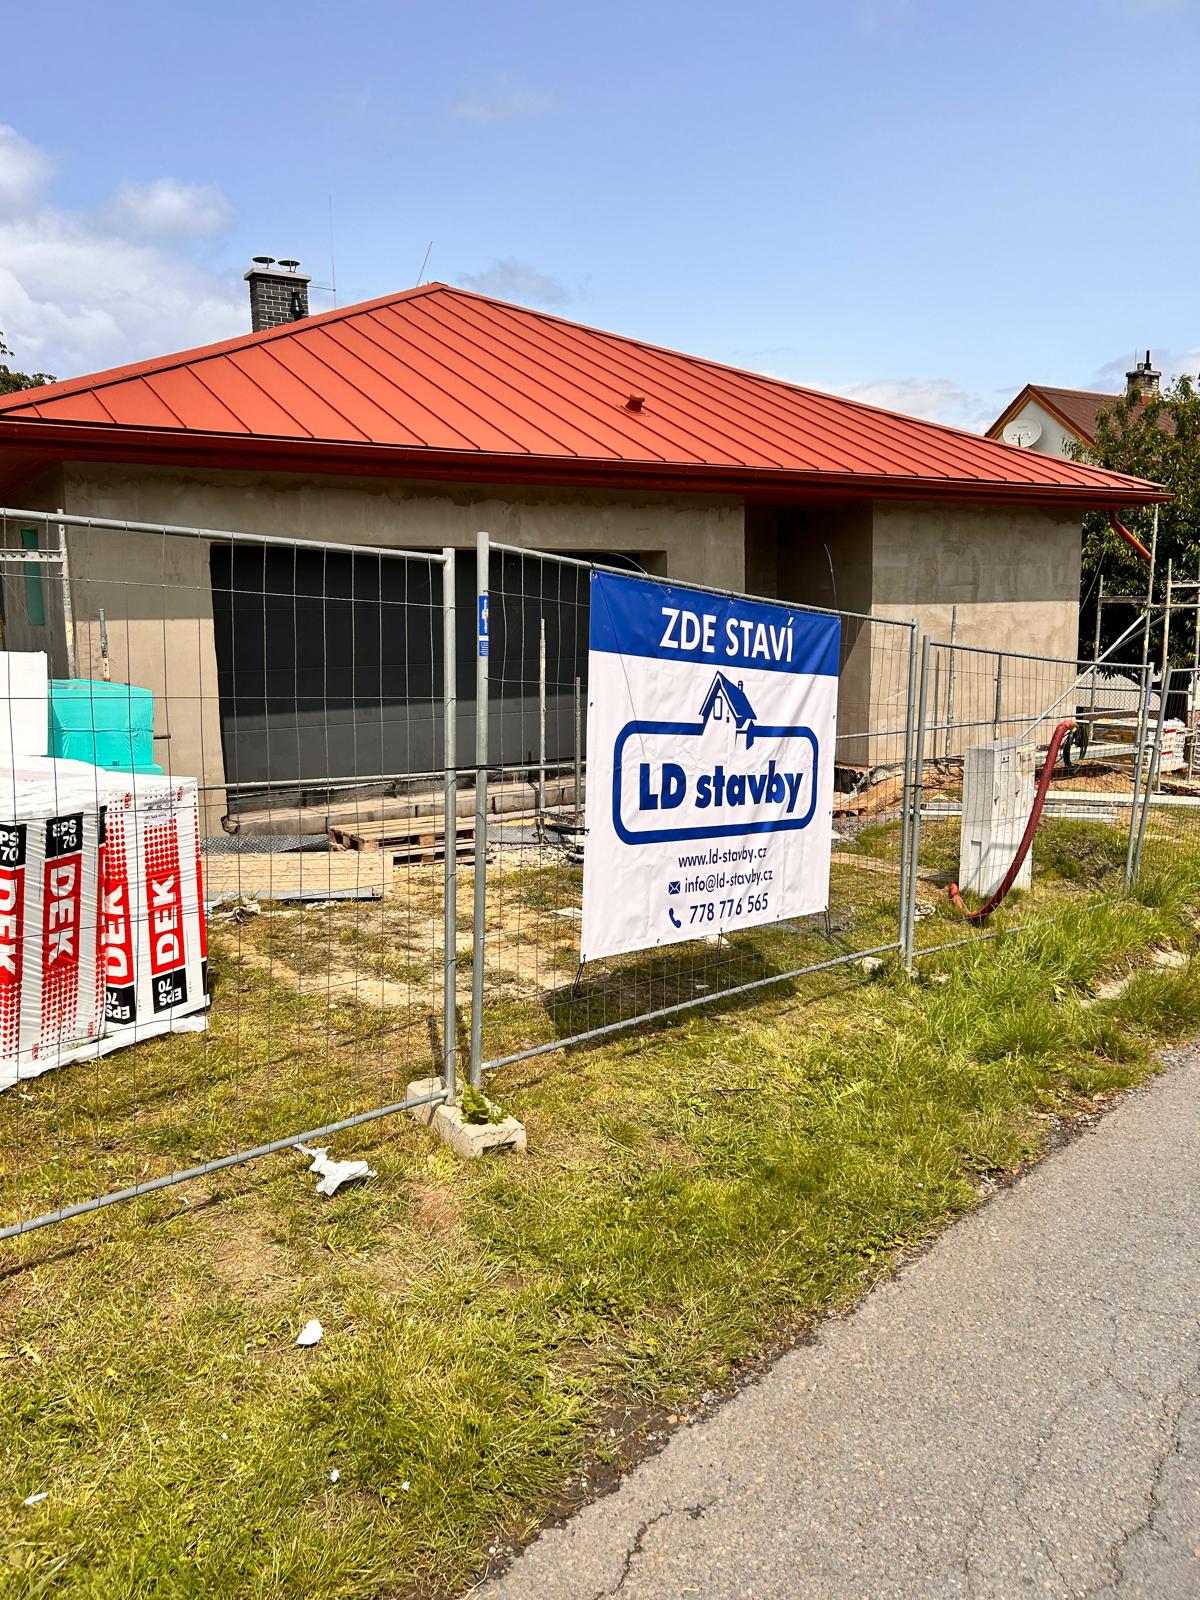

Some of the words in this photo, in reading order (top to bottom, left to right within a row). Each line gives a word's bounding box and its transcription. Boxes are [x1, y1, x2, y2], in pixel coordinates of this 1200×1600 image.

[660, 607, 717, 653] ZDE
[725, 616, 793, 662] STAVÍ
[638, 762, 687, 811] LD
[695, 760, 803, 813] stavby
[0, 831, 19, 846] PS
[52, 818, 77, 838] EPS
[63, 834, 77, 849] 70
[0, 846, 19, 862] 70
[678, 845, 767, 869] www.ld-stavby.cz
[684, 868, 773, 894] info@ld-stavby.cz
[48, 863, 75, 966] DEK
[689, 901, 715, 925] 778
[718, 897, 743, 920] 776
[746, 892, 769, 914] 565
[152, 874, 180, 966] DEK
[158, 977, 172, 993] 70
[159, 988, 182, 1006] EPS
[106, 1005, 130, 1020] EPS
